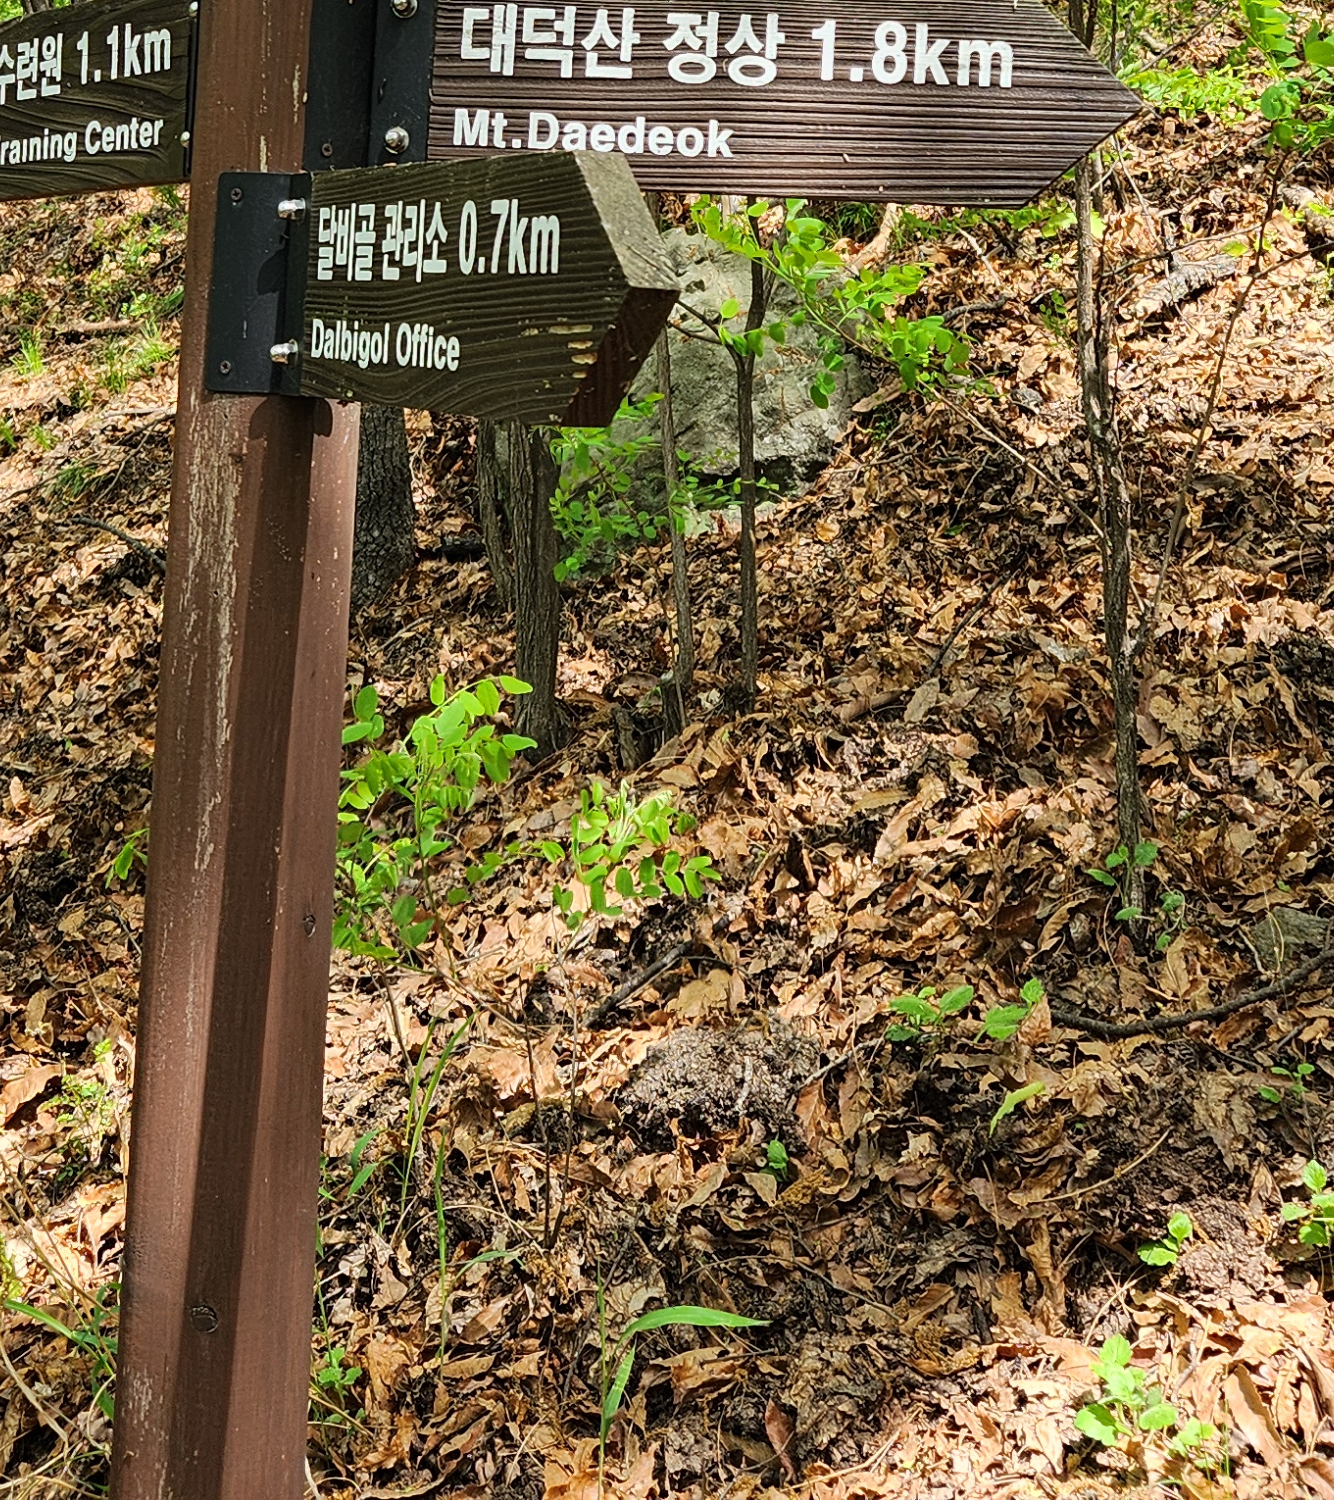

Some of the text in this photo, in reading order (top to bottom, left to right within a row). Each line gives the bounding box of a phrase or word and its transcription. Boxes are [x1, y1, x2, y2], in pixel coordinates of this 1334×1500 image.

[77, 22, 172, 85] 1.1km
[460, 3, 1013, 88] 대덕산 정상 1.8km
[85, 117, 164, 155] Center
[452, 108, 735, 158] Mt.Daedeok
[317, 198, 560, 283] 달비골 관리소 0.7km
[310, 318, 460, 371] Dalbigol Office
